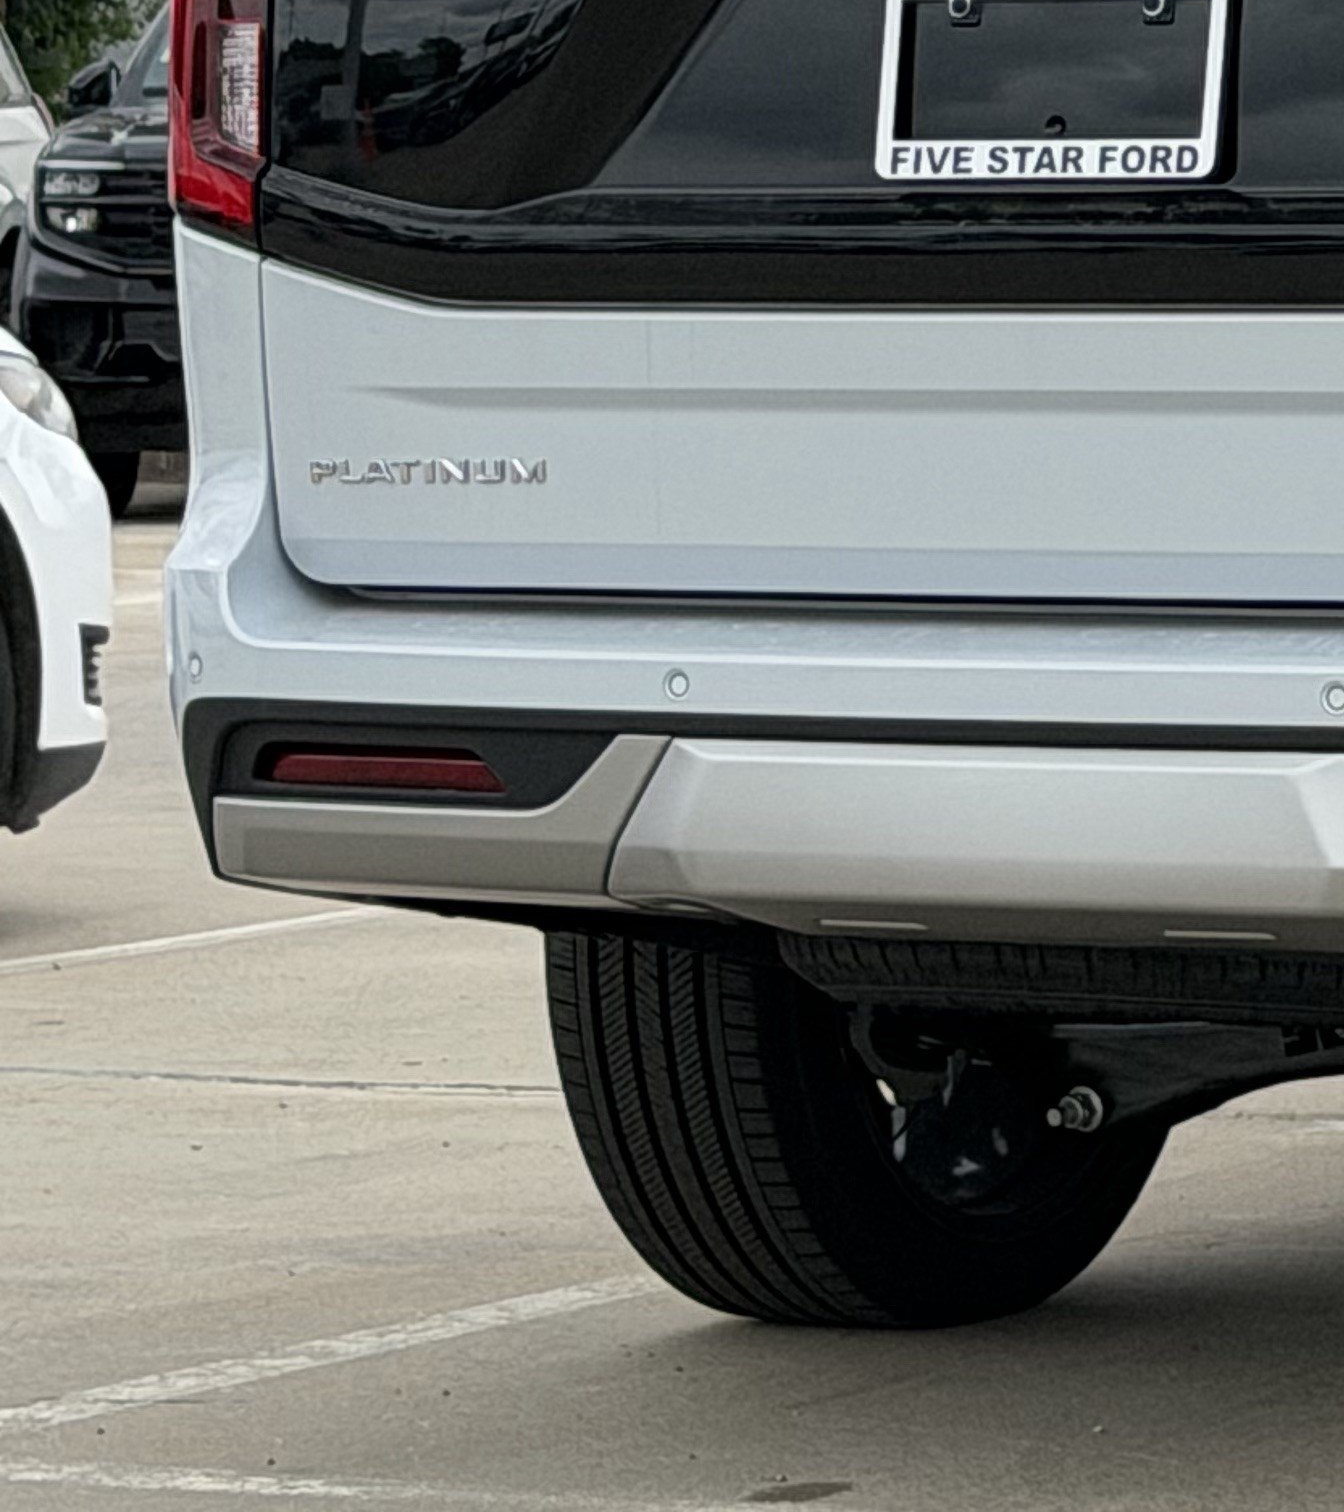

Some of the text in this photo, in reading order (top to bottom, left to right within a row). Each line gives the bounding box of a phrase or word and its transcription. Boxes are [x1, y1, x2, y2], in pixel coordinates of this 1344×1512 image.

[890, 144, 1199, 175] FIVE STAR FORD
[310, 457, 548, 485] PLATINUM
